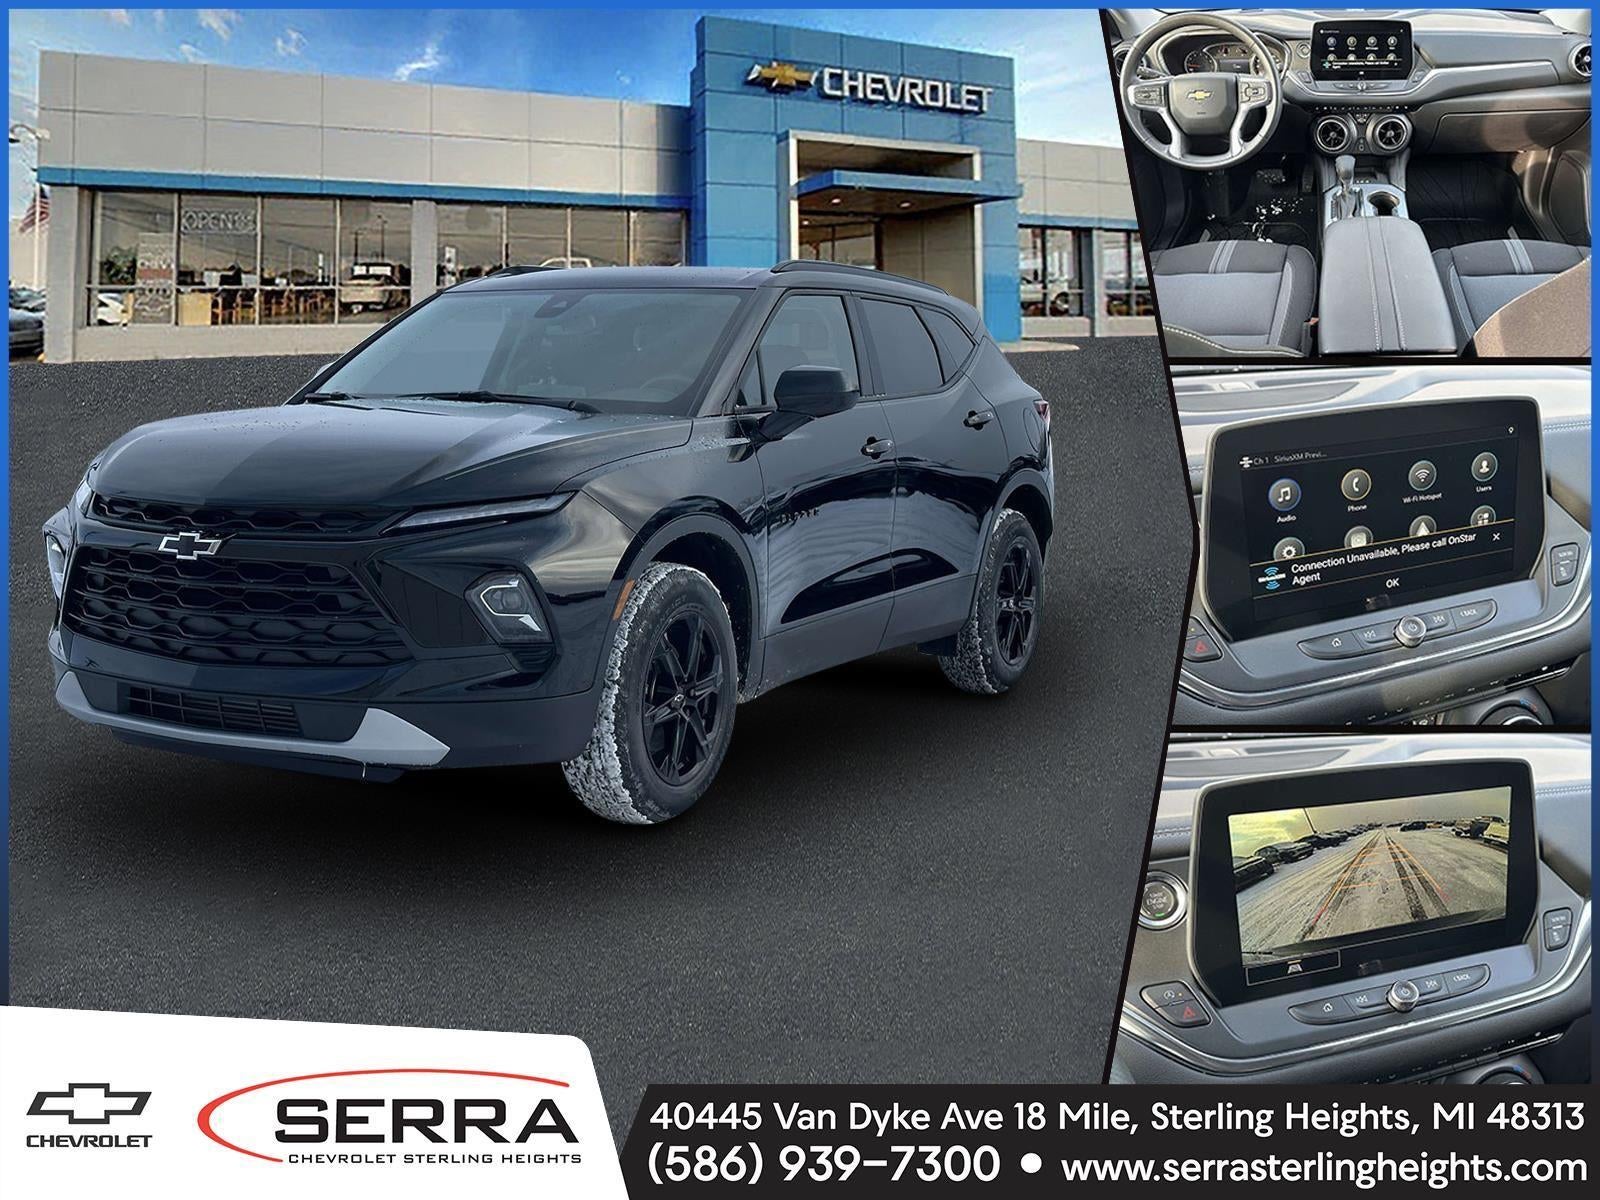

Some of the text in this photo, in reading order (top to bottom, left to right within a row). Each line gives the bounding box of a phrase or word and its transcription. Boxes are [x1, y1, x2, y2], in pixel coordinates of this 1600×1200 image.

[822, 67, 994, 112] CHEVROLET
[1475, 485, 1492, 493] Users
[1402, 492, 1442, 504] Wi-Fi Hotspot
[1347, 504, 1367, 512] Phone
[1277, 514, 1297, 524] Audio
[1291, 556, 1345, 573] Connection
[1401, 541, 1431, 554] Please
[1432, 537, 1447, 549] call
[1447, 533, 1477, 545] OnStar
[1292, 572, 1321, 587] Agent
[1385, 577, 1400, 588] OK
